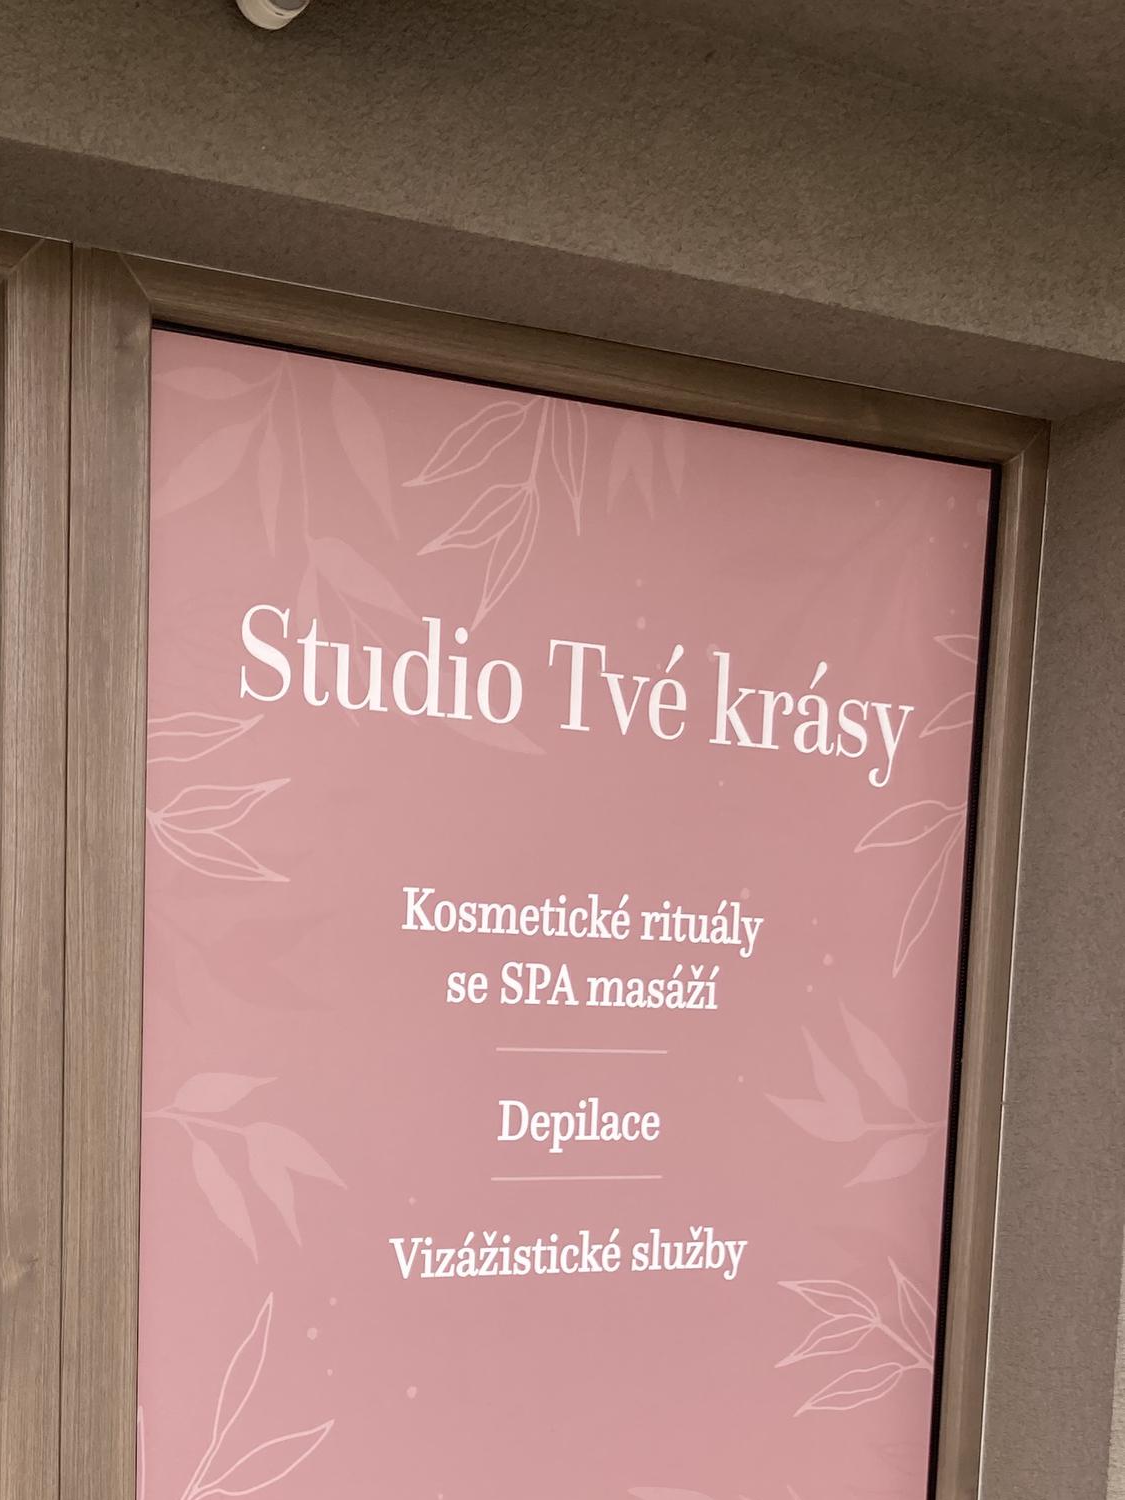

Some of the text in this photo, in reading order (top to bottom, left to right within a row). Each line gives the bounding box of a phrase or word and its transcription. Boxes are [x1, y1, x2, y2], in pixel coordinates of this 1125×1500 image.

[240, 604, 915, 788] Studio Tvé krásy
[401, 886, 764, 958] Kosmetické rituály
[446, 961, 720, 1010] se SPA masáží
[497, 1097, 660, 1153] Depilace
[389, 1226, 748, 1281] Vizážistické služby
